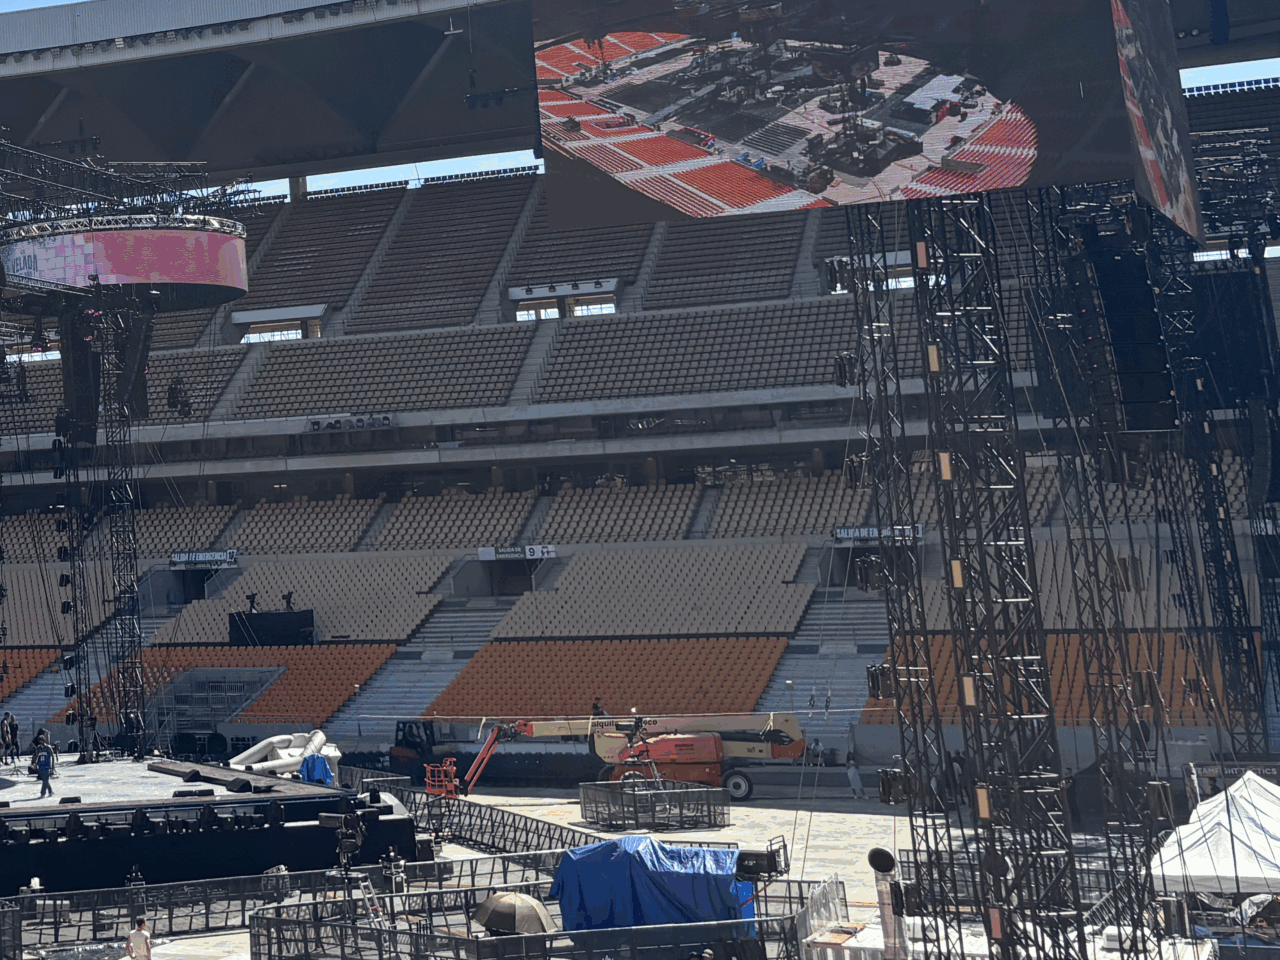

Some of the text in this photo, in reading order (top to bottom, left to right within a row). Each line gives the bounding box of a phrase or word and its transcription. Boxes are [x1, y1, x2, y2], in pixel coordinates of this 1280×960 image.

[11, 254, 38, 274] VELADA
[836, 527, 860, 538] SALIDA
[860, 527, 869, 537] DE
[528, 547, 535, 557] 9
[1196, 767, 1277, 775] EAMFIGHT TCTICS
